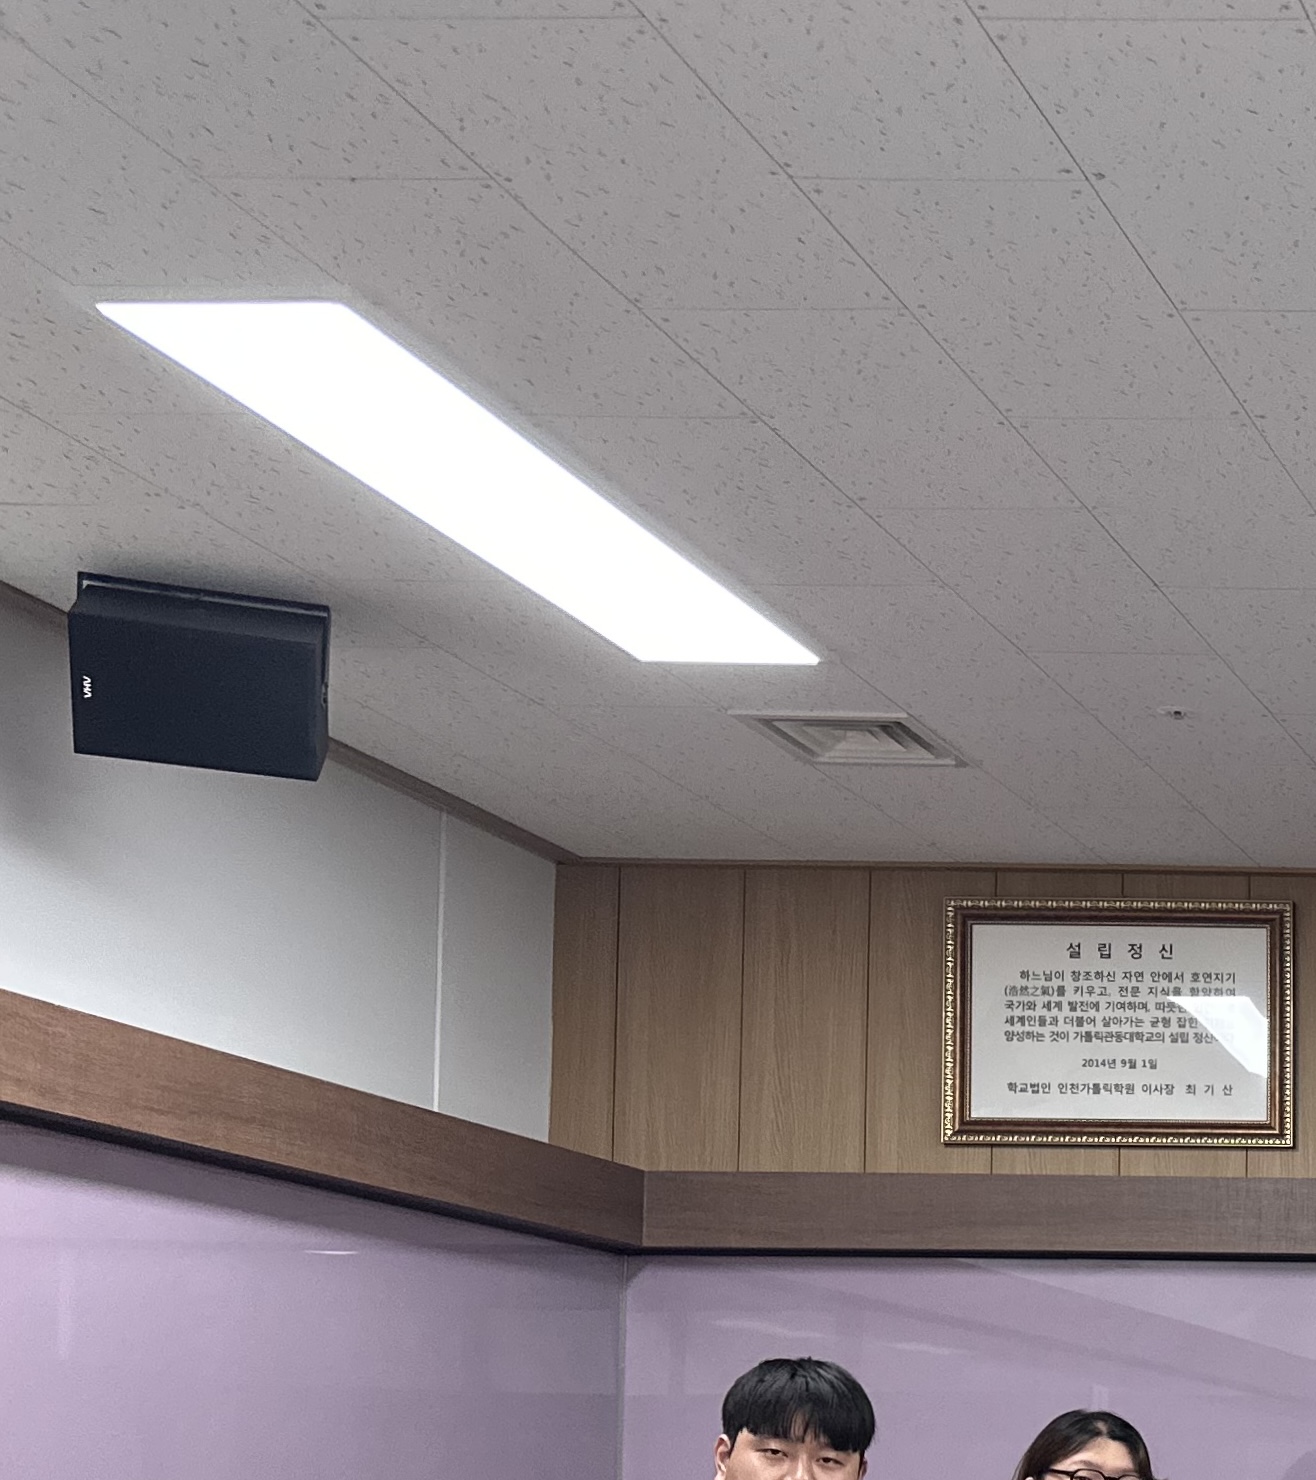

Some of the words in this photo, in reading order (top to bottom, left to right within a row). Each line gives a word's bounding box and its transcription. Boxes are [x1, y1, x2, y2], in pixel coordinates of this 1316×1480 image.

[1019, 970, 1065, 982] 하느님이
[1070, 970, 1116, 983] 창조하신
[1121, 971, 1144, 983] 자연
[1150, 971, 1184, 984] 안에서
[1190, 972, 1236, 984] 호연지기
[1118, 986, 1141, 998] 전문
[1148, 986, 1182, 998] 지식을
[1004, 1000, 1037, 1012] 국가와
[1042, 1000, 1062, 1013] 세계
[1068, 1000, 1100, 1013] 발전에
[1004, 1016, 1059, 1028] 세계인들과
[1064, 1016, 1096, 1029] 더불어
[1101, 1017, 1145, 1029] 살아가는
[1150, 1017, 1171, 1029] 균형
[1004, 1031, 1046, 1043] 양성하는
[1049, 1031, 1070, 1043] 것이
[1073, 1031, 1165, 1044] 가톨릭관동대학교의
[1168, 1032, 1189, 1044] 설립
[1082, 1059, 1117, 1069] 2014년
[1120, 1059, 1137, 1069] 9월
[1142, 1059, 1158, 1069] 1일
[1007, 1082, 1051, 1094] 학교법인
[1058, 1083, 1135, 1095] 인천가톨릭학원
[1142, 1084, 1175, 1096] 이사장
